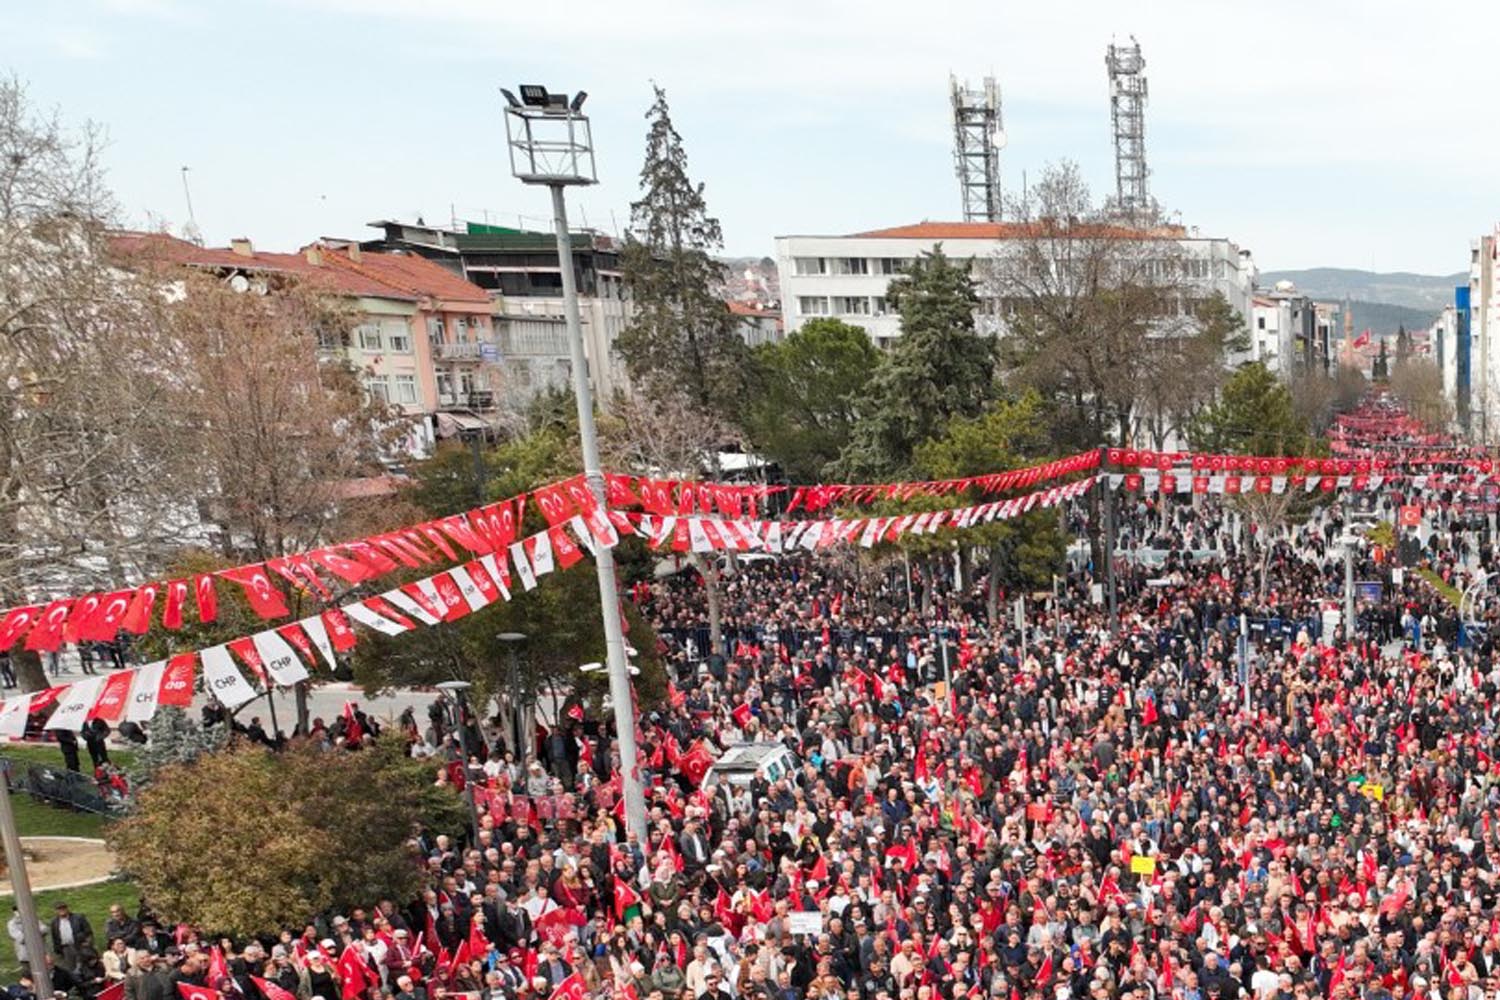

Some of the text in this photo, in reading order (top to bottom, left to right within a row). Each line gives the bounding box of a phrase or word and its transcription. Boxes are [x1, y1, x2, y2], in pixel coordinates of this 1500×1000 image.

[270, 656, 292, 670] CHP
[215, 675, 237, 689] CHP
[136, 692, 153, 703] CH
